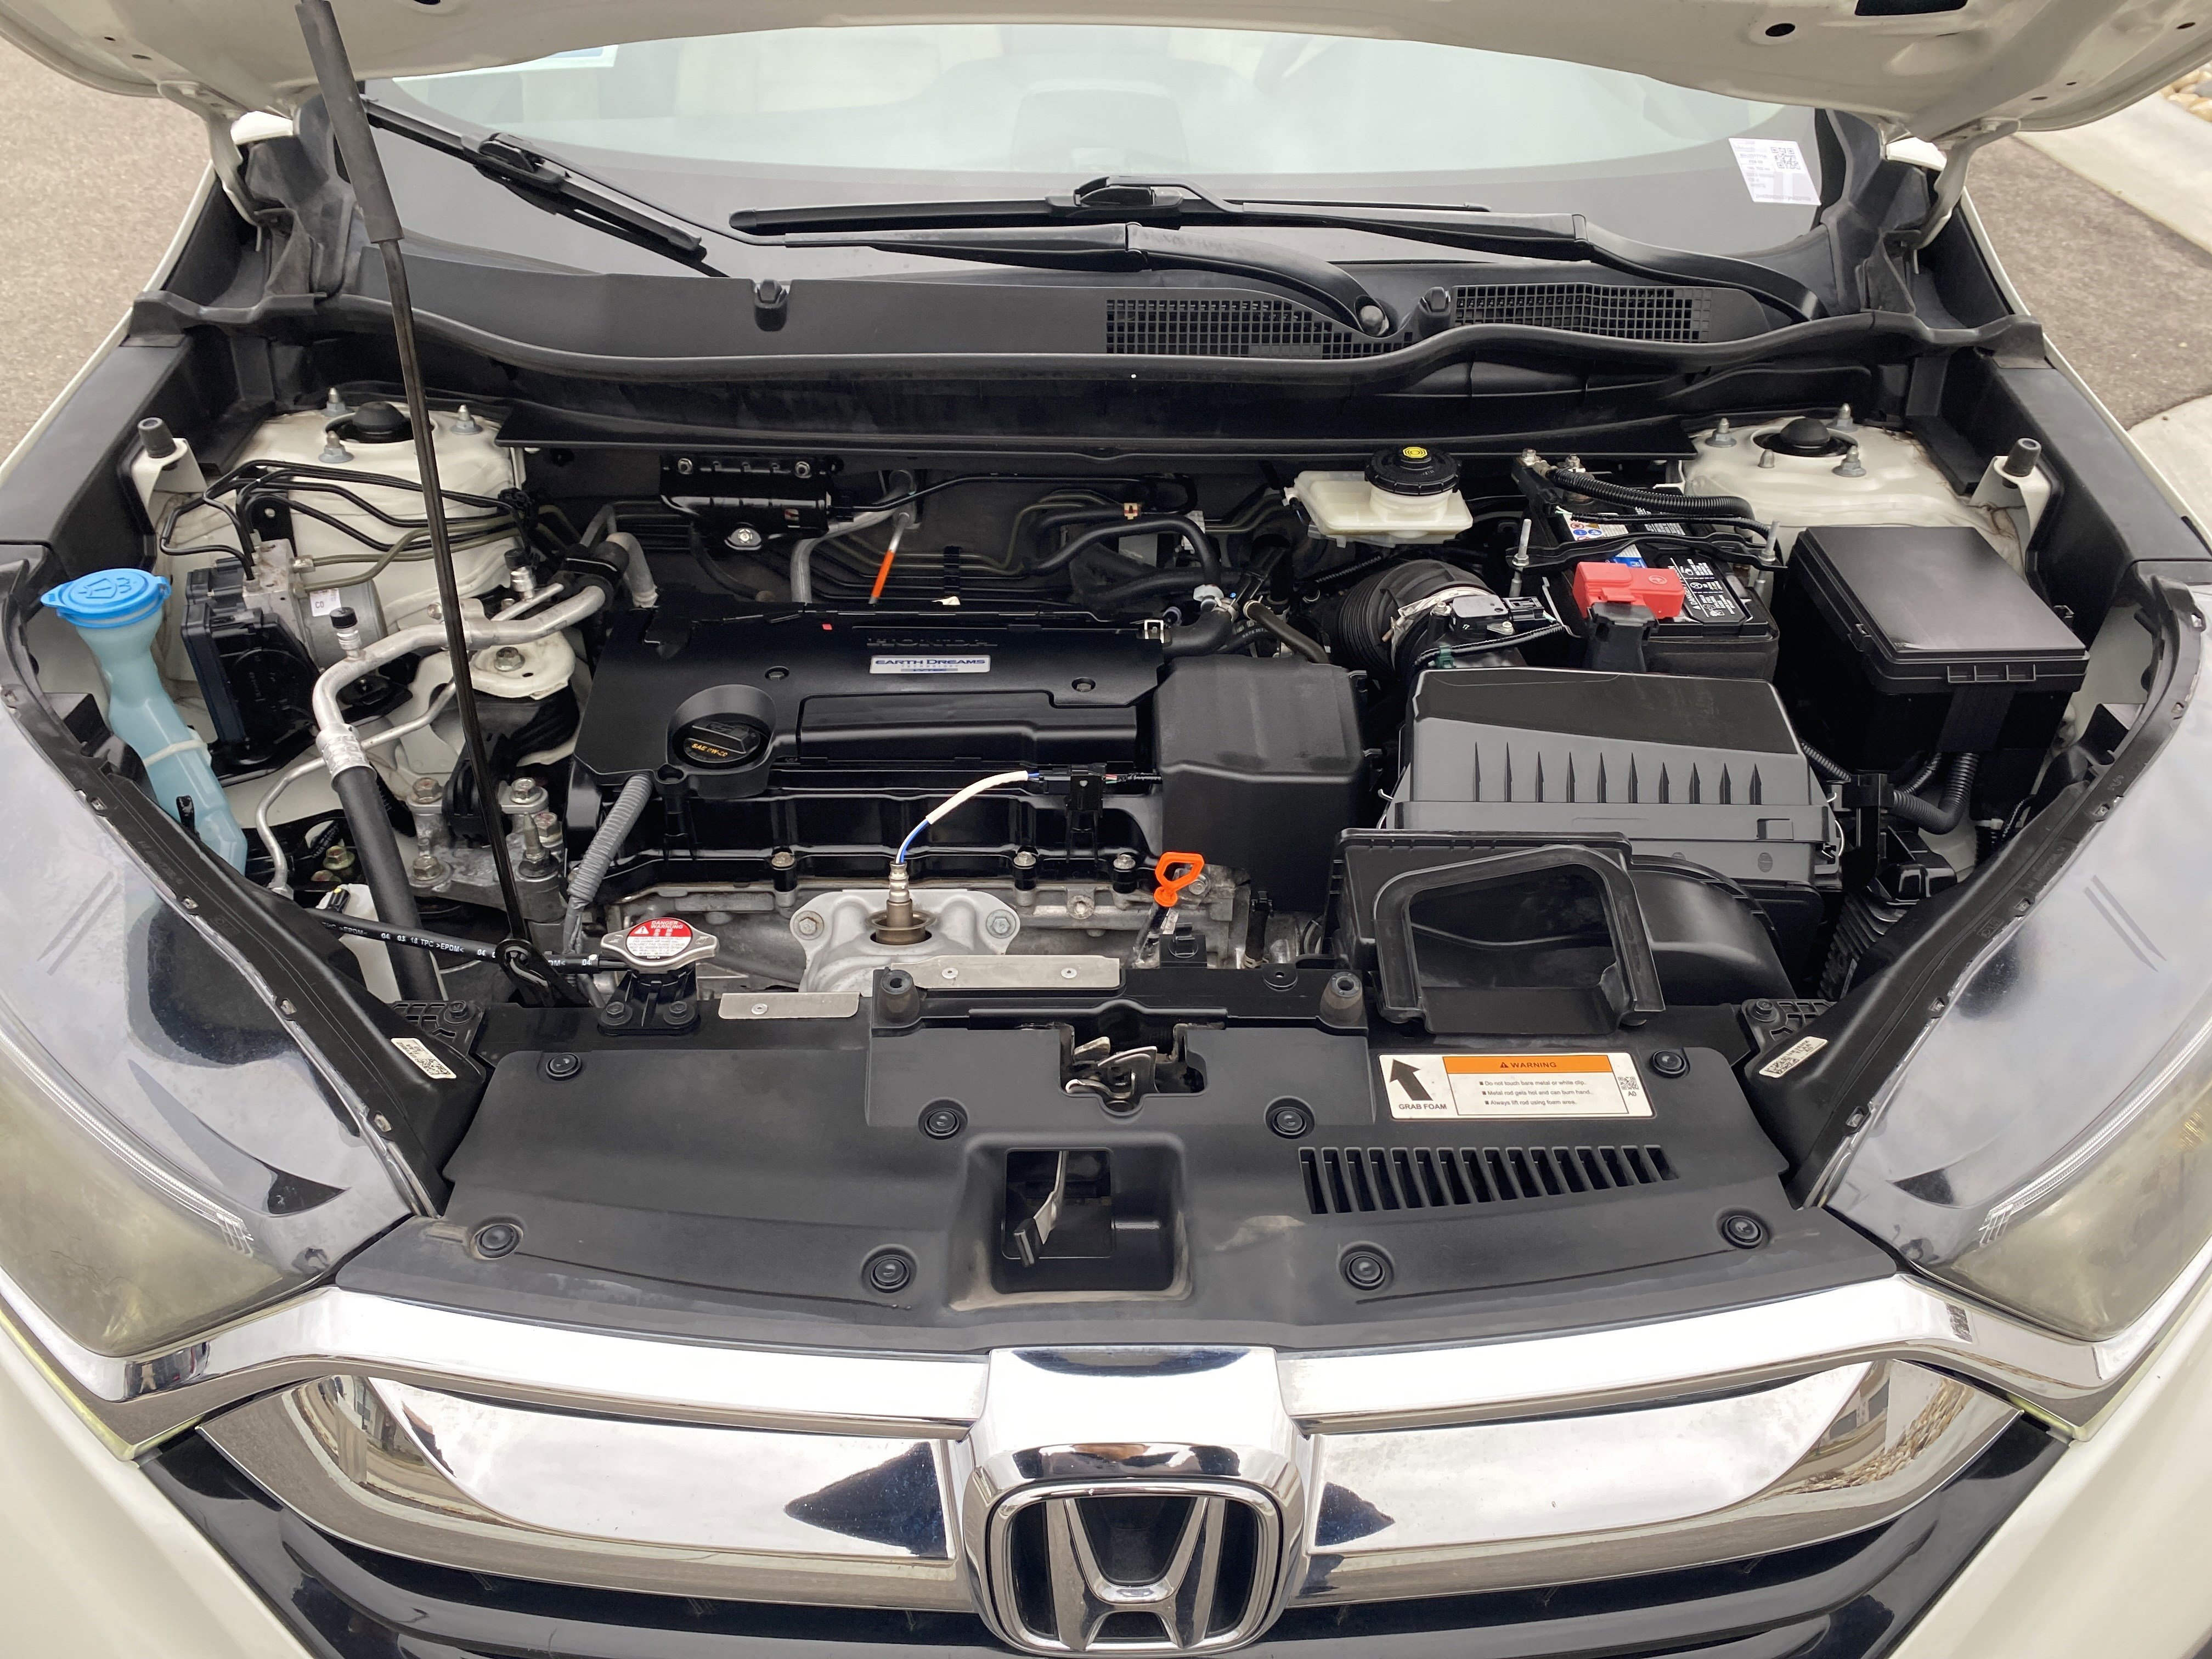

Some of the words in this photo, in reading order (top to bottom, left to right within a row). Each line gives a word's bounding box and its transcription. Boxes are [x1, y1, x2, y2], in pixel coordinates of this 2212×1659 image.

[867, 638, 998, 647] HONDA
[707, 748, 728, 757] 0W-20
[420, 939, 433, 947] TPC
[436, 943, 464, 952] >EPDM<
[476, 949, 486, 957] 04
